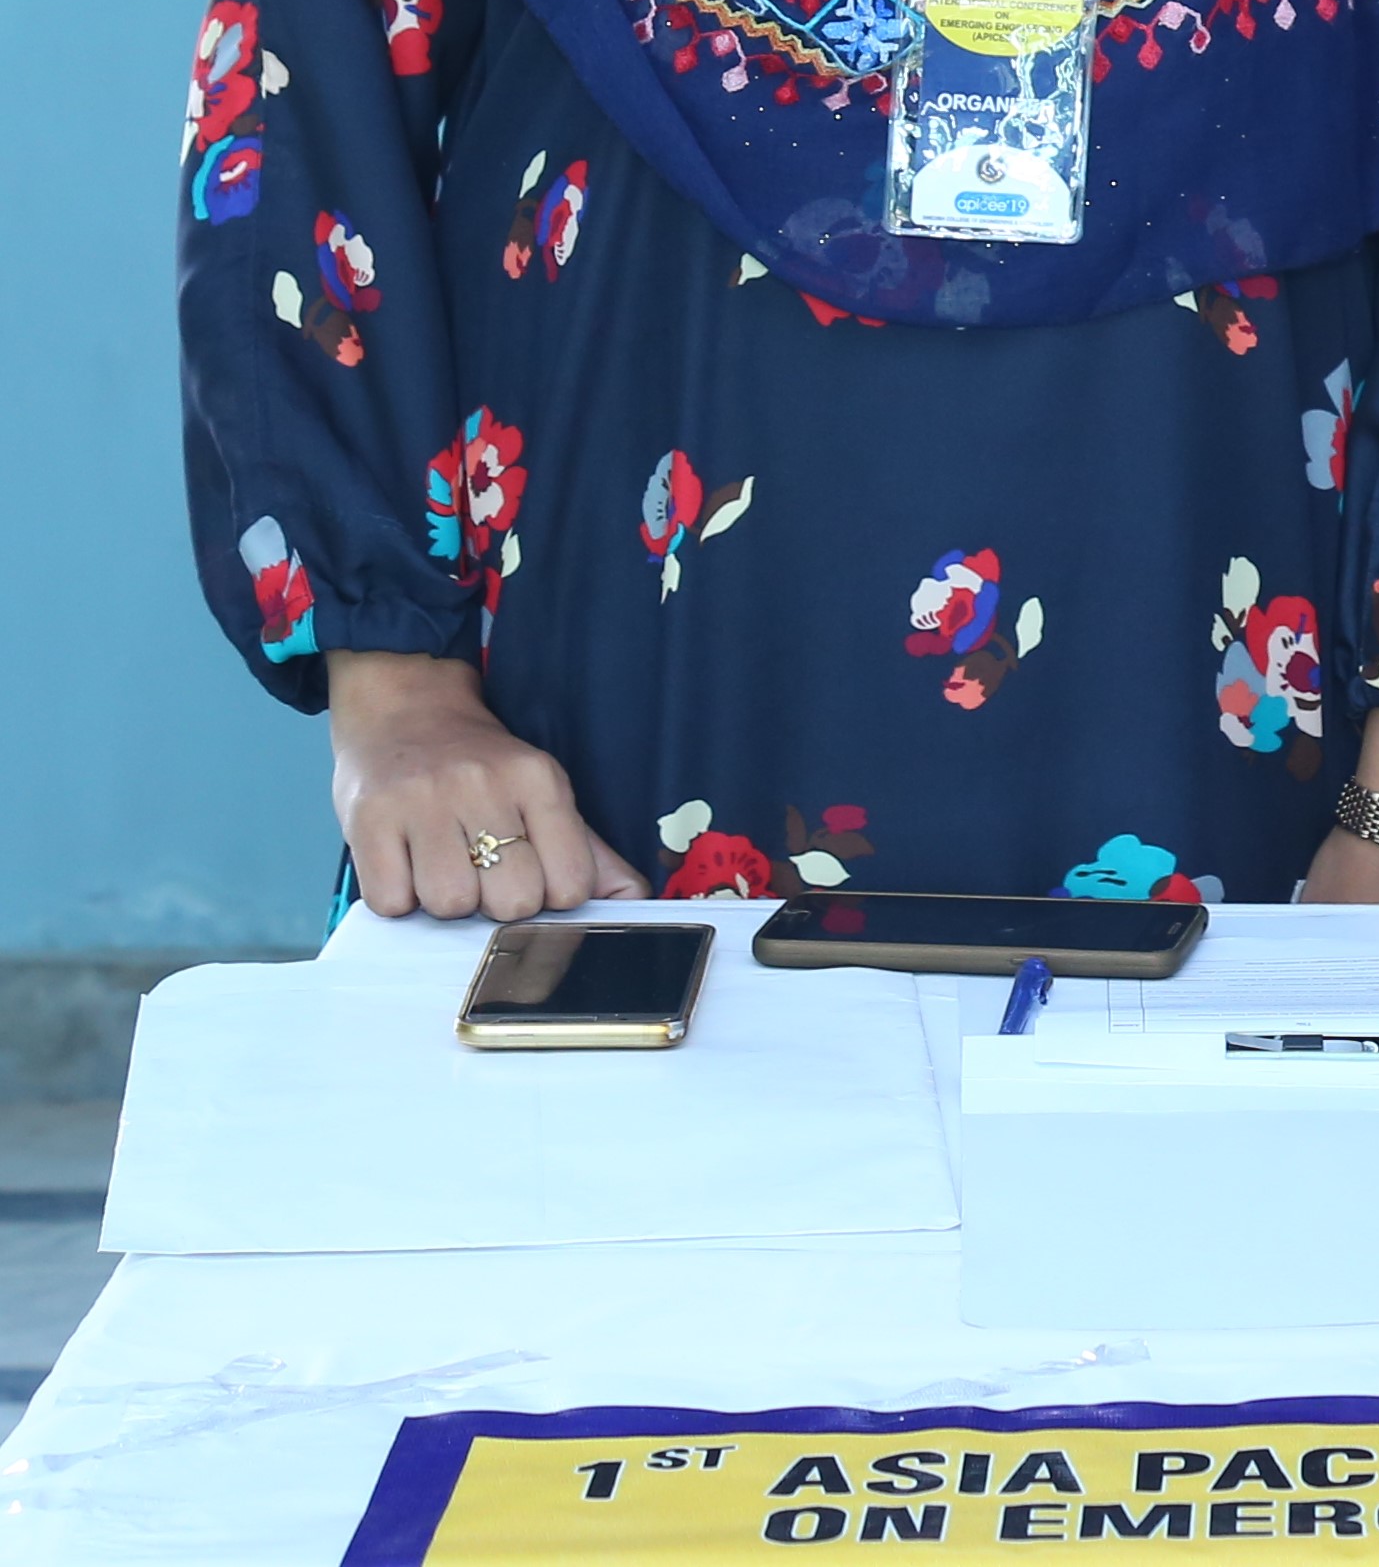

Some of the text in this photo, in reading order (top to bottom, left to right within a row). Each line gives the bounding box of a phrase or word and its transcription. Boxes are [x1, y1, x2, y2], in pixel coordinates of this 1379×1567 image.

[940, 19, 993, 31] EMERGING
[994, 11, 1009, 20] ON
[767, 1451, 1083, 1498] ASIA
[761, 1502, 947, 1545] ON
